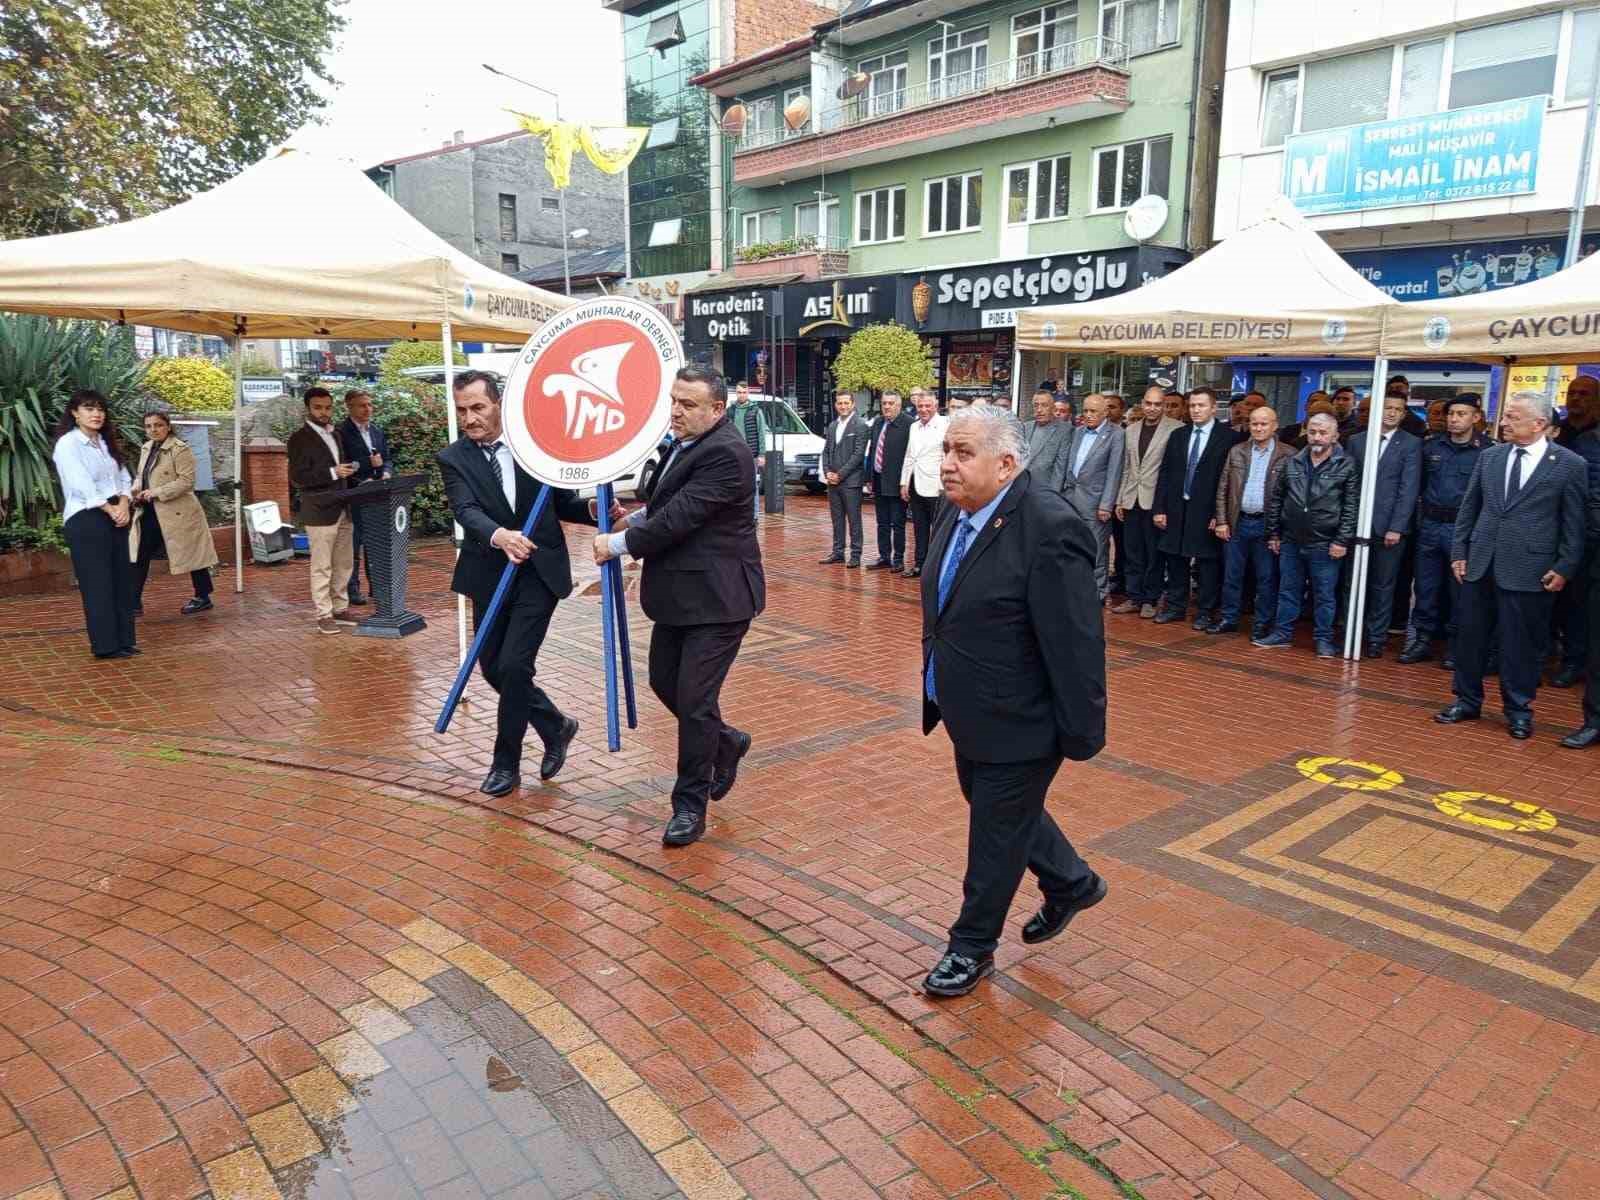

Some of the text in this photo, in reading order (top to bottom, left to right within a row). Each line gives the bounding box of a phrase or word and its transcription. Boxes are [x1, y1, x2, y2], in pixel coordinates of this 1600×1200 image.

[1388, 131, 1496, 158] MALİ MÜŞAVİR
[1355, 151, 1531, 192] İSMAİL İNAM
[1445, 186, 1473, 197] 0372
[938, 255, 1127, 308] Sepetçioğlu
[488, 293, 530, 319] ÇAYCUMA
[693, 291, 764, 316] Karadeniz
[524, 317, 573, 365] ÇAYCUMA
[576, 306, 642, 321] MUHTARLAR
[641, 317, 676, 362] DERNEĞİ
[708, 316, 750, 340] Optik
[1079, 318, 1292, 343] ÇAYCUMA BELEDİYESİ
[560, 467, 590, 480] 1986
